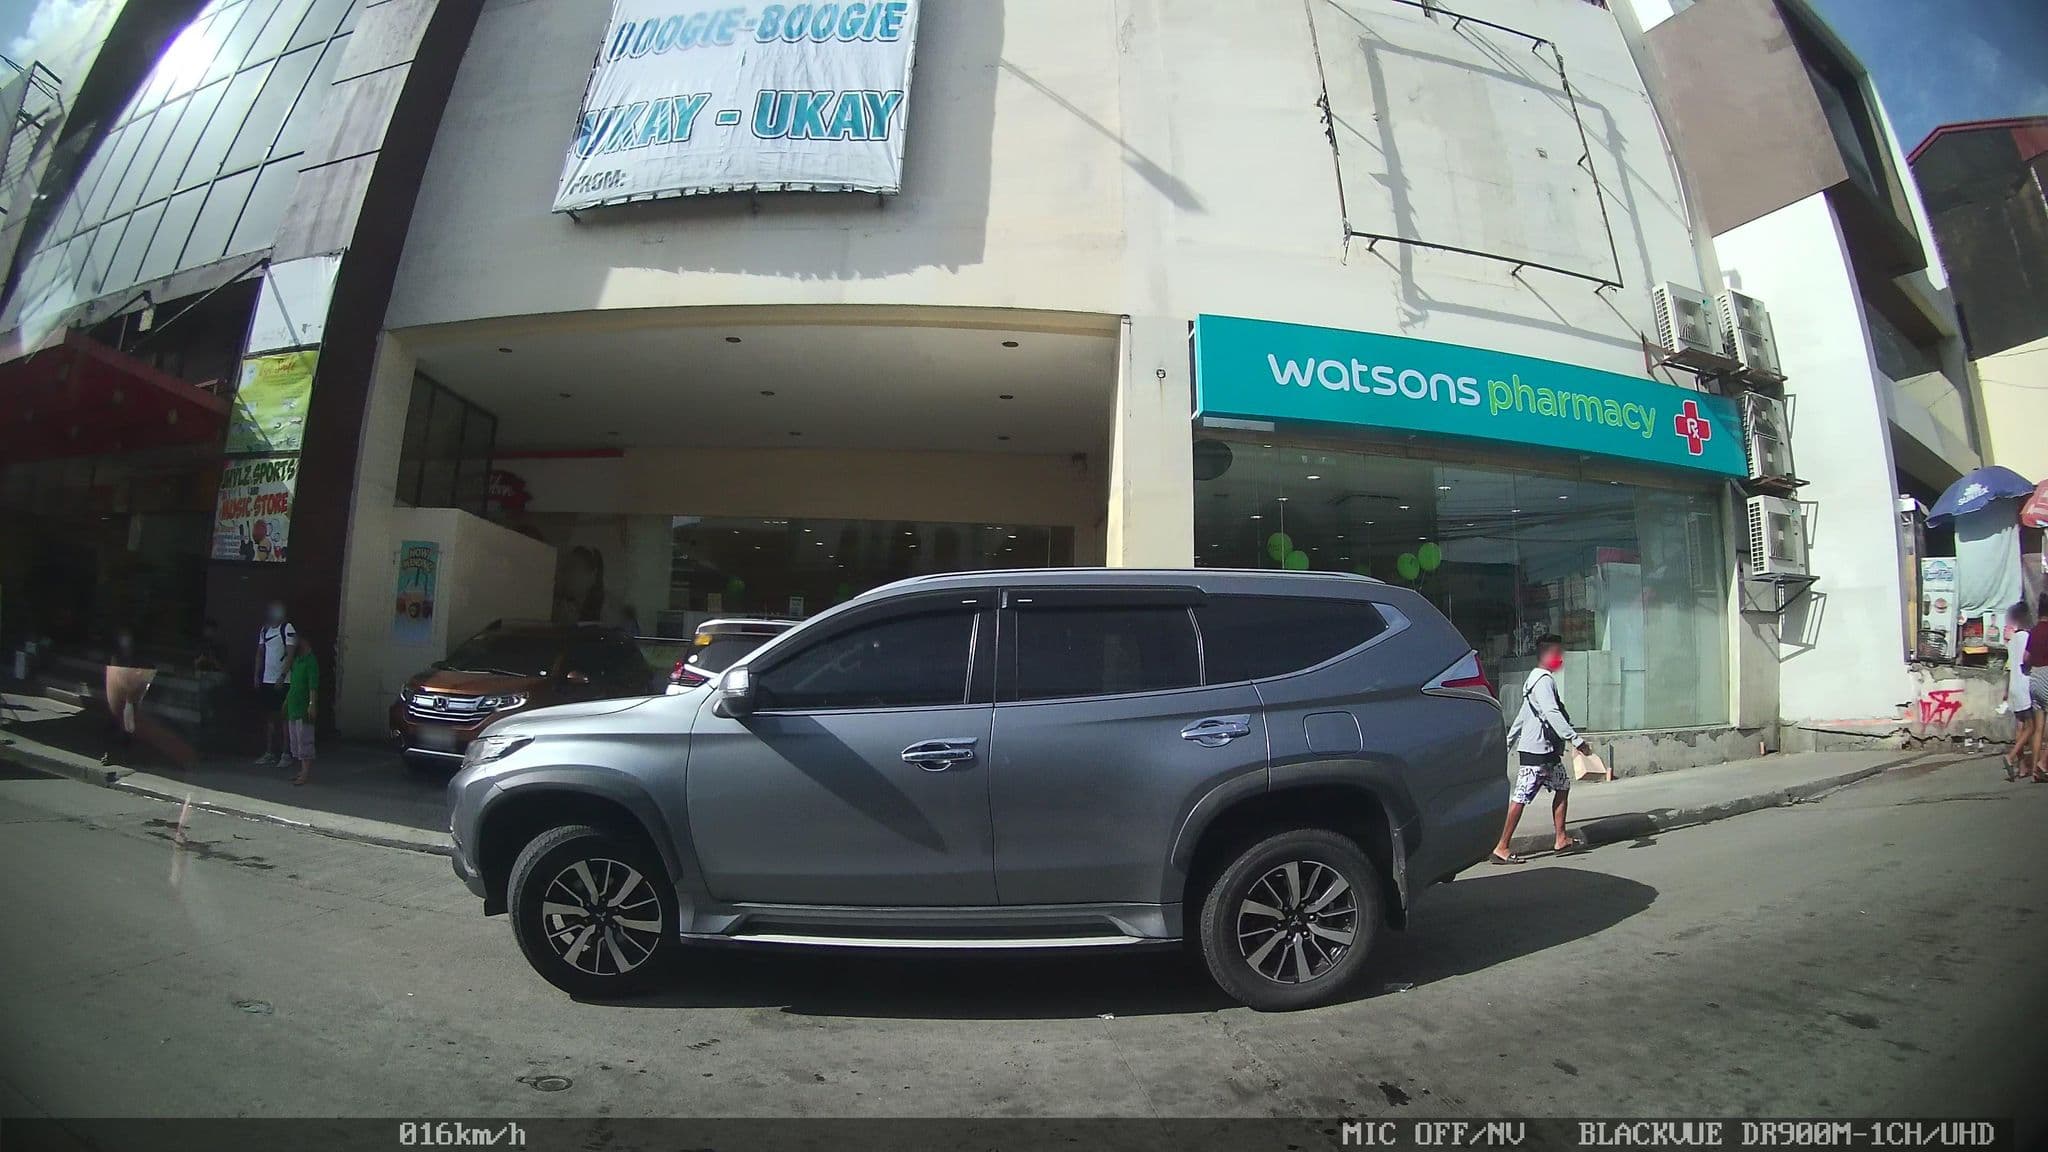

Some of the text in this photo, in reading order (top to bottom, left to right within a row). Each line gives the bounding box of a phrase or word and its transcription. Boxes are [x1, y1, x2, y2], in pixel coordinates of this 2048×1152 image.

[751, 89, 903, 141] UKAY
[1267, 353, 1656, 439] watsons pharmacy
[253, 459, 295, 485] SPORTS
[253, 492, 289, 517] STORE
